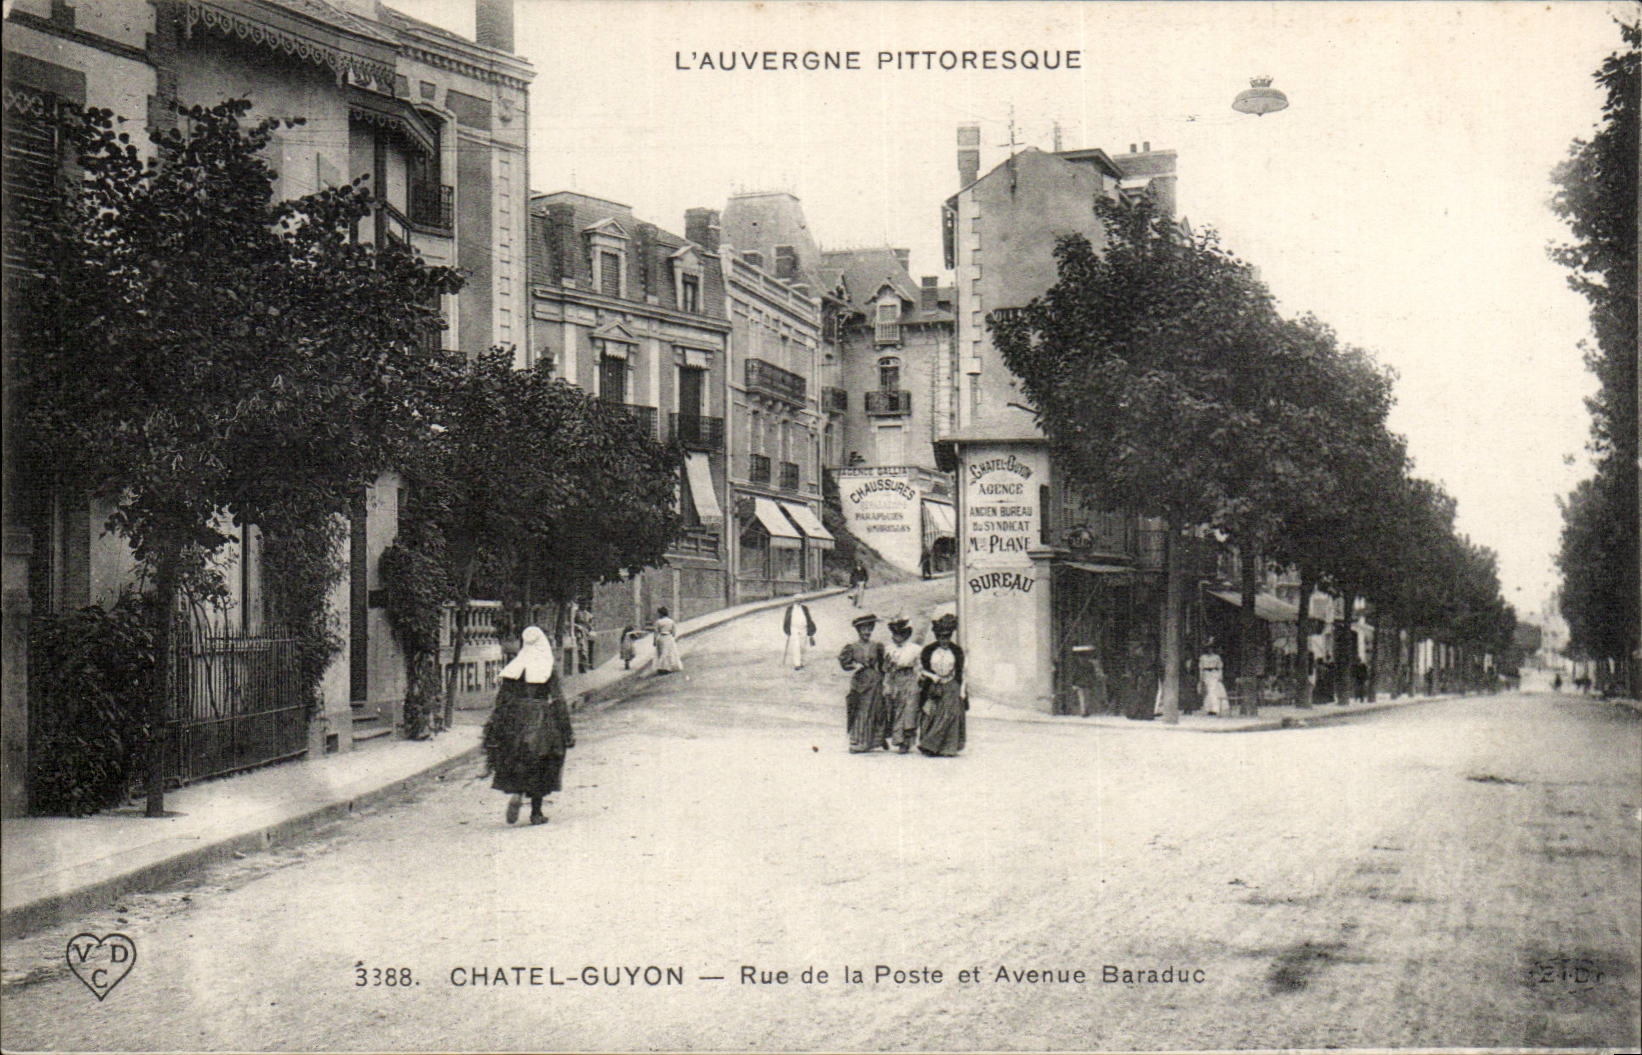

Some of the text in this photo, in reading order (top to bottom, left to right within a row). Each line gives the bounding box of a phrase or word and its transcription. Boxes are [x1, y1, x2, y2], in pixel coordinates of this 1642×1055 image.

[850, 479, 916, 504] CHAUSSURES
[979, 483, 1024, 496] AGENCE
[969, 506, 1033, 517] ANCIEN BUREAU
[984, 520, 1030, 532] SYNDICAT
[968, 571, 1034, 594] BUREAU
